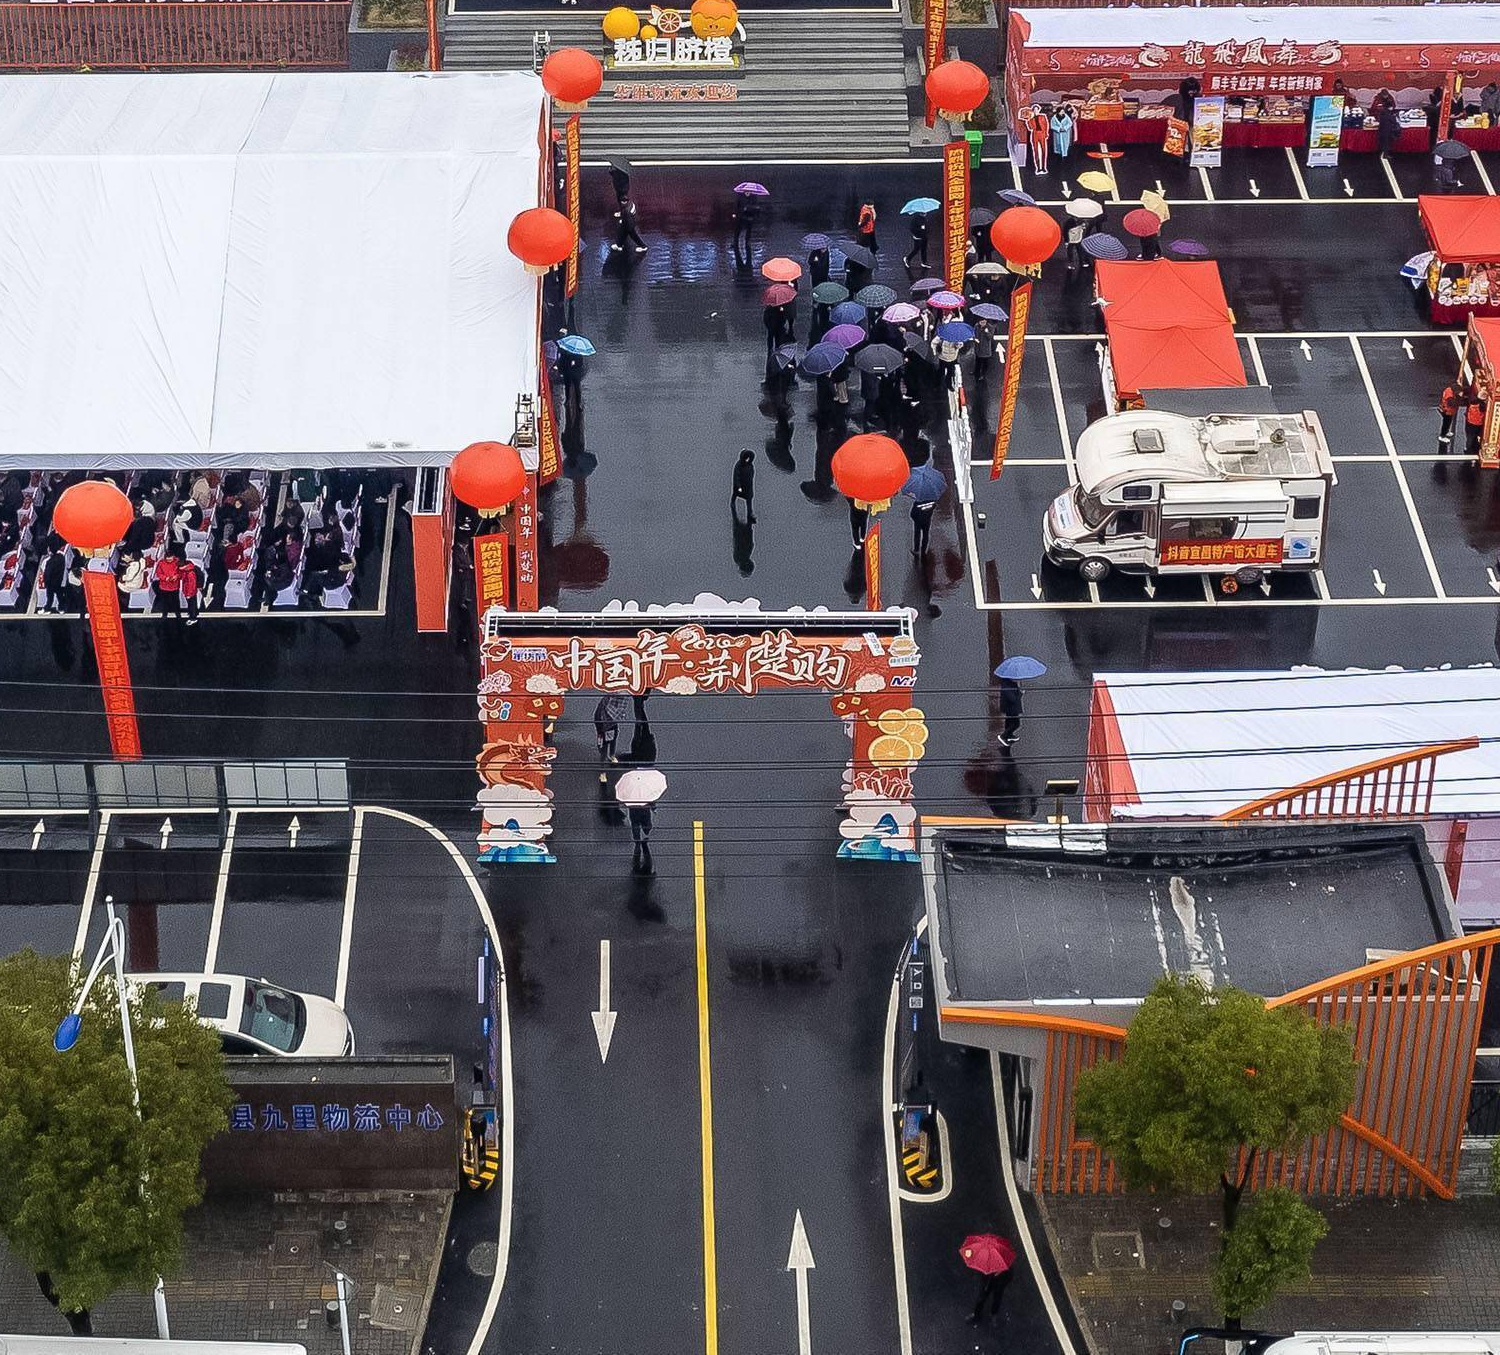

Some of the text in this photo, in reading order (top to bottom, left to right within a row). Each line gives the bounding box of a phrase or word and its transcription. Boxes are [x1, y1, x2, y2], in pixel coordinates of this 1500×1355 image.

[614, 37, 733, 64] 秭归脐橙
[231, 1102, 445, 1132] 县九里物流中心
